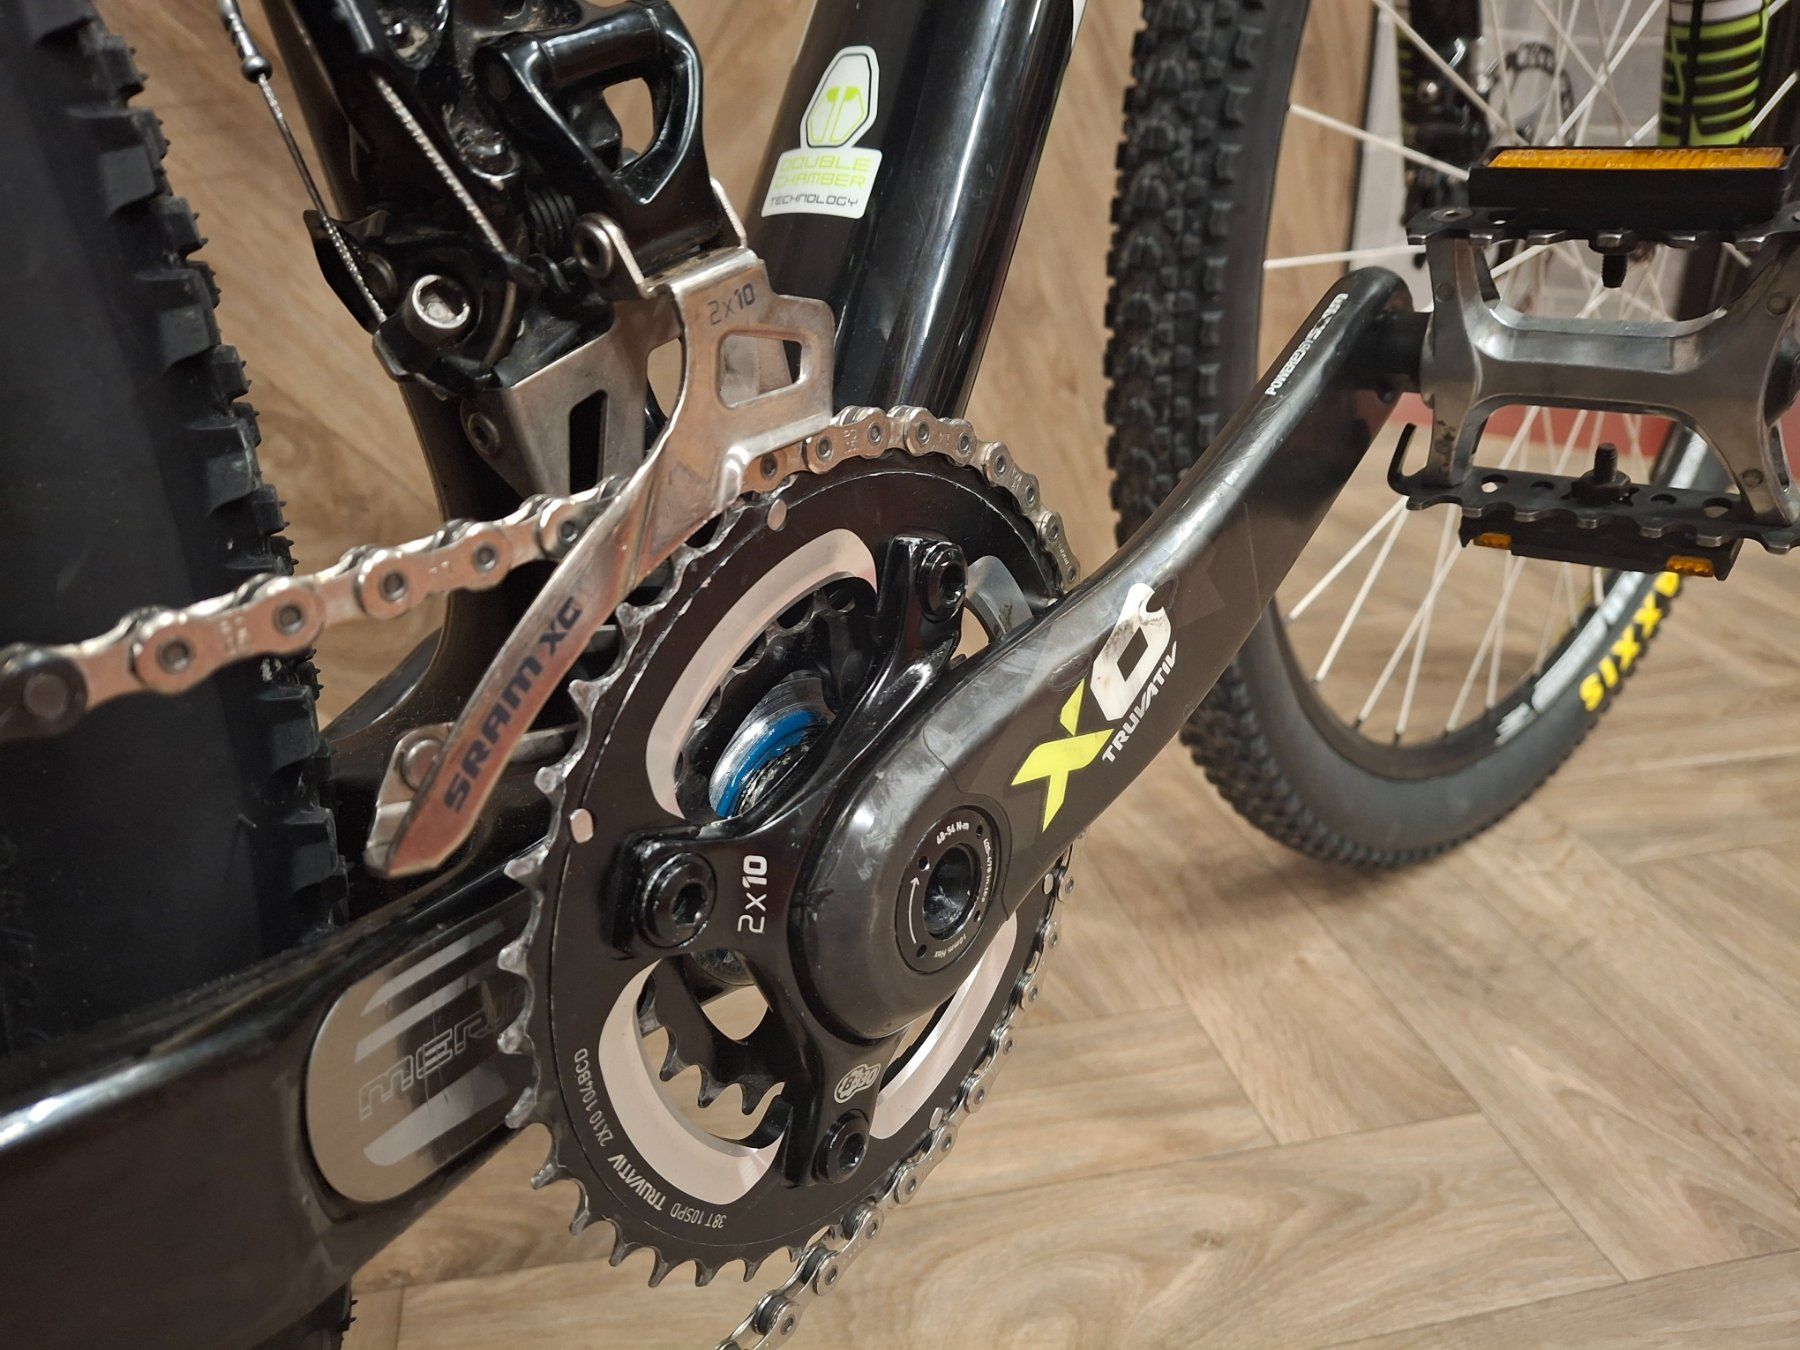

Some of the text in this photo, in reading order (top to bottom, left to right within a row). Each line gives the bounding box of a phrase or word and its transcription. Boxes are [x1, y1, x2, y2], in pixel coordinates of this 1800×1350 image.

[780, 155, 871, 173] DOUBLE
[774, 172, 867, 191] CHAMBER
[770, 193, 859, 208] TECHNOLOGY
[1102, 640, 1177, 764] TRUVATIV
[443, 655, 544, 814] SRAM
[608, 1153, 667, 1212] TRUVATIV
[705, 1214, 727, 1229] 38T
